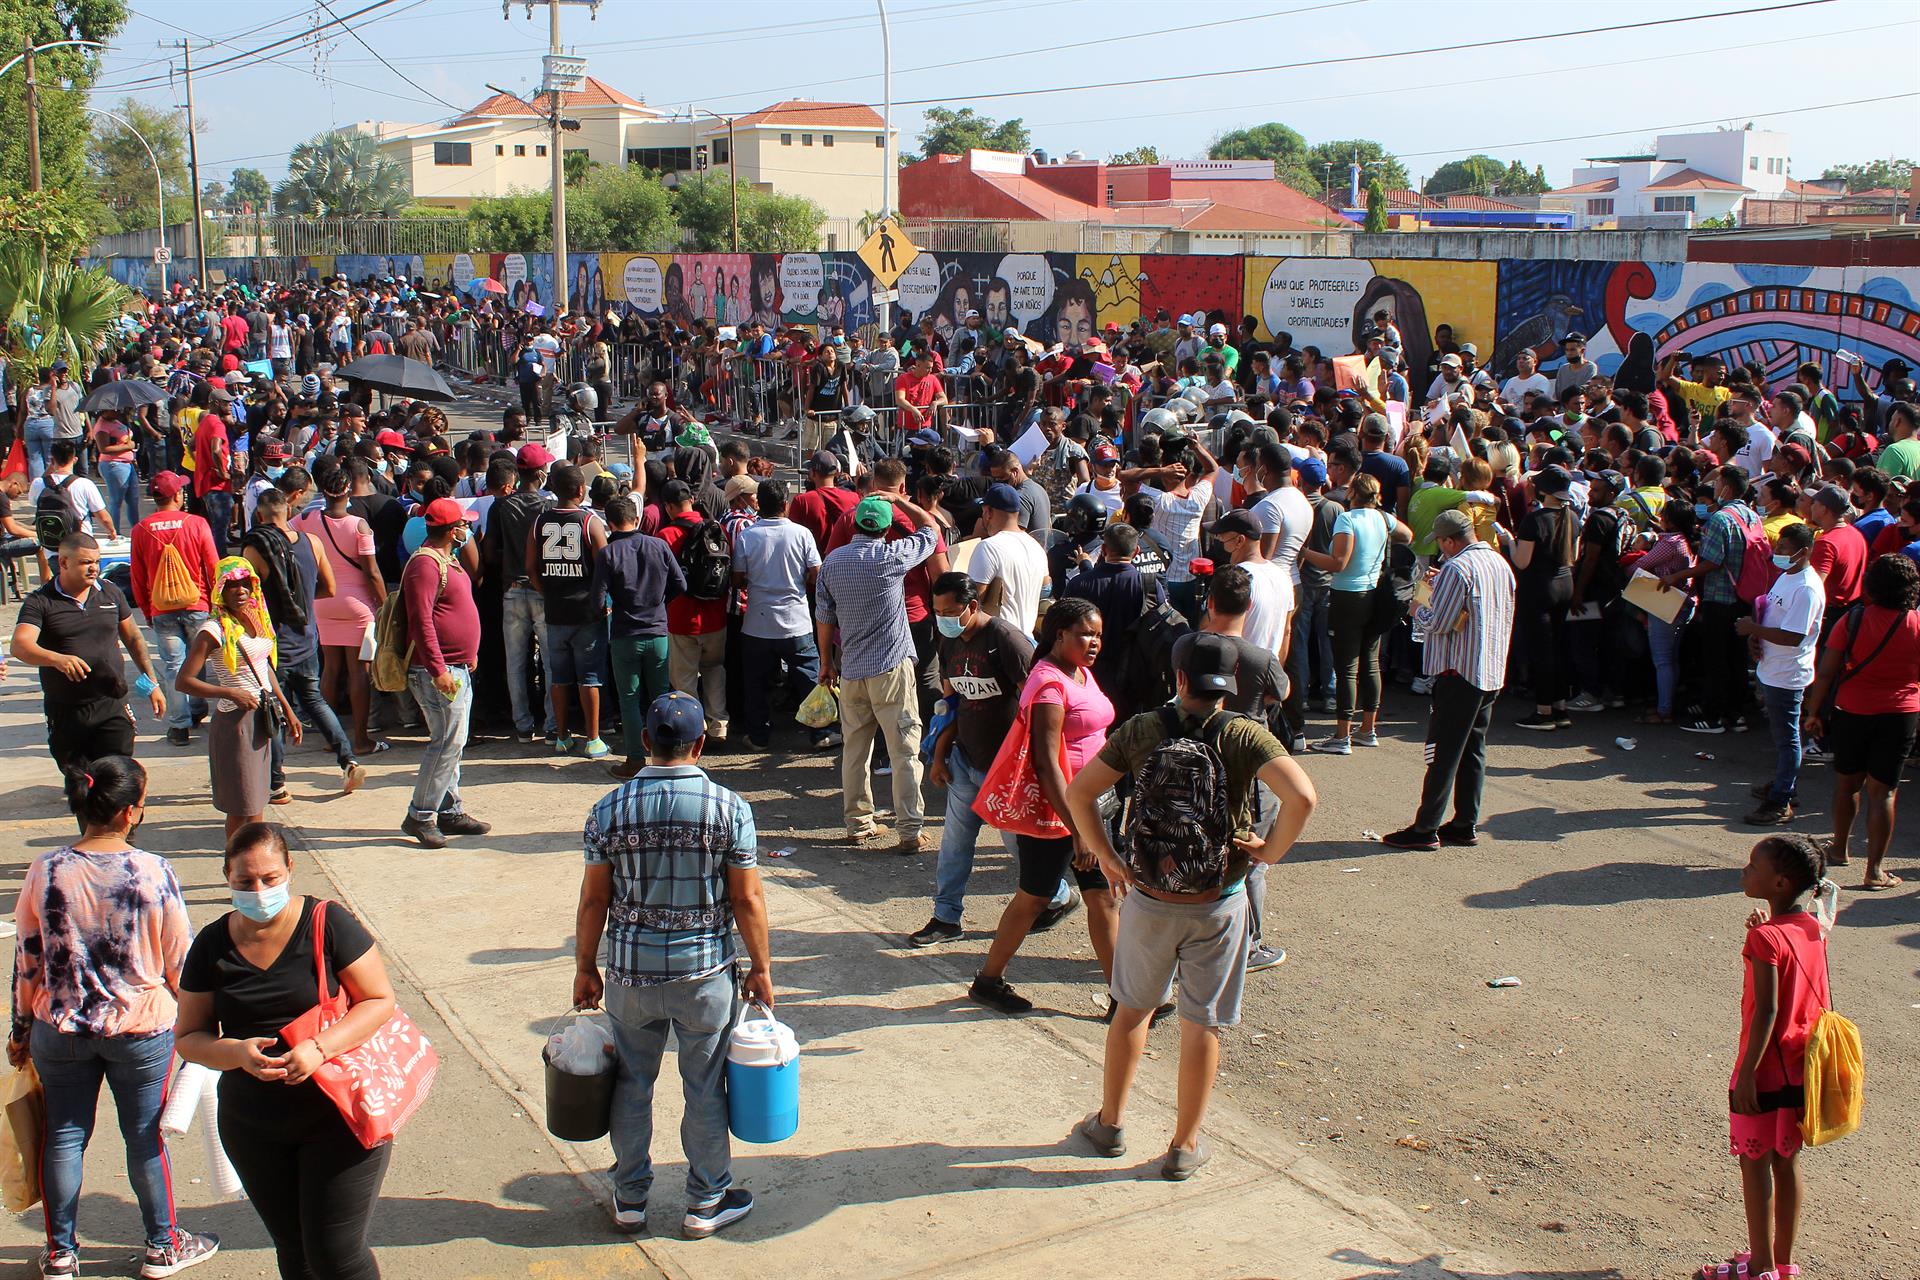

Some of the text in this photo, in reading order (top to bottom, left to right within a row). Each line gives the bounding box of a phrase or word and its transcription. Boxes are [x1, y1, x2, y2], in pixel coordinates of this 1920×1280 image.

[1016, 271, 1037, 280] PORQUE
[1031, 286, 1045, 296] TODO
[1289, 280, 1304, 291] QUE
[1308, 279, 1360, 292] PROTEGERLES
[1013, 299, 1042, 310] SON NIÑOS
[1290, 296, 1325, 309] Y DARLES
[149, 519, 183, 532] TEAM
[541, 522, 583, 561] 23
[541, 562, 584, 578] JORDAN
